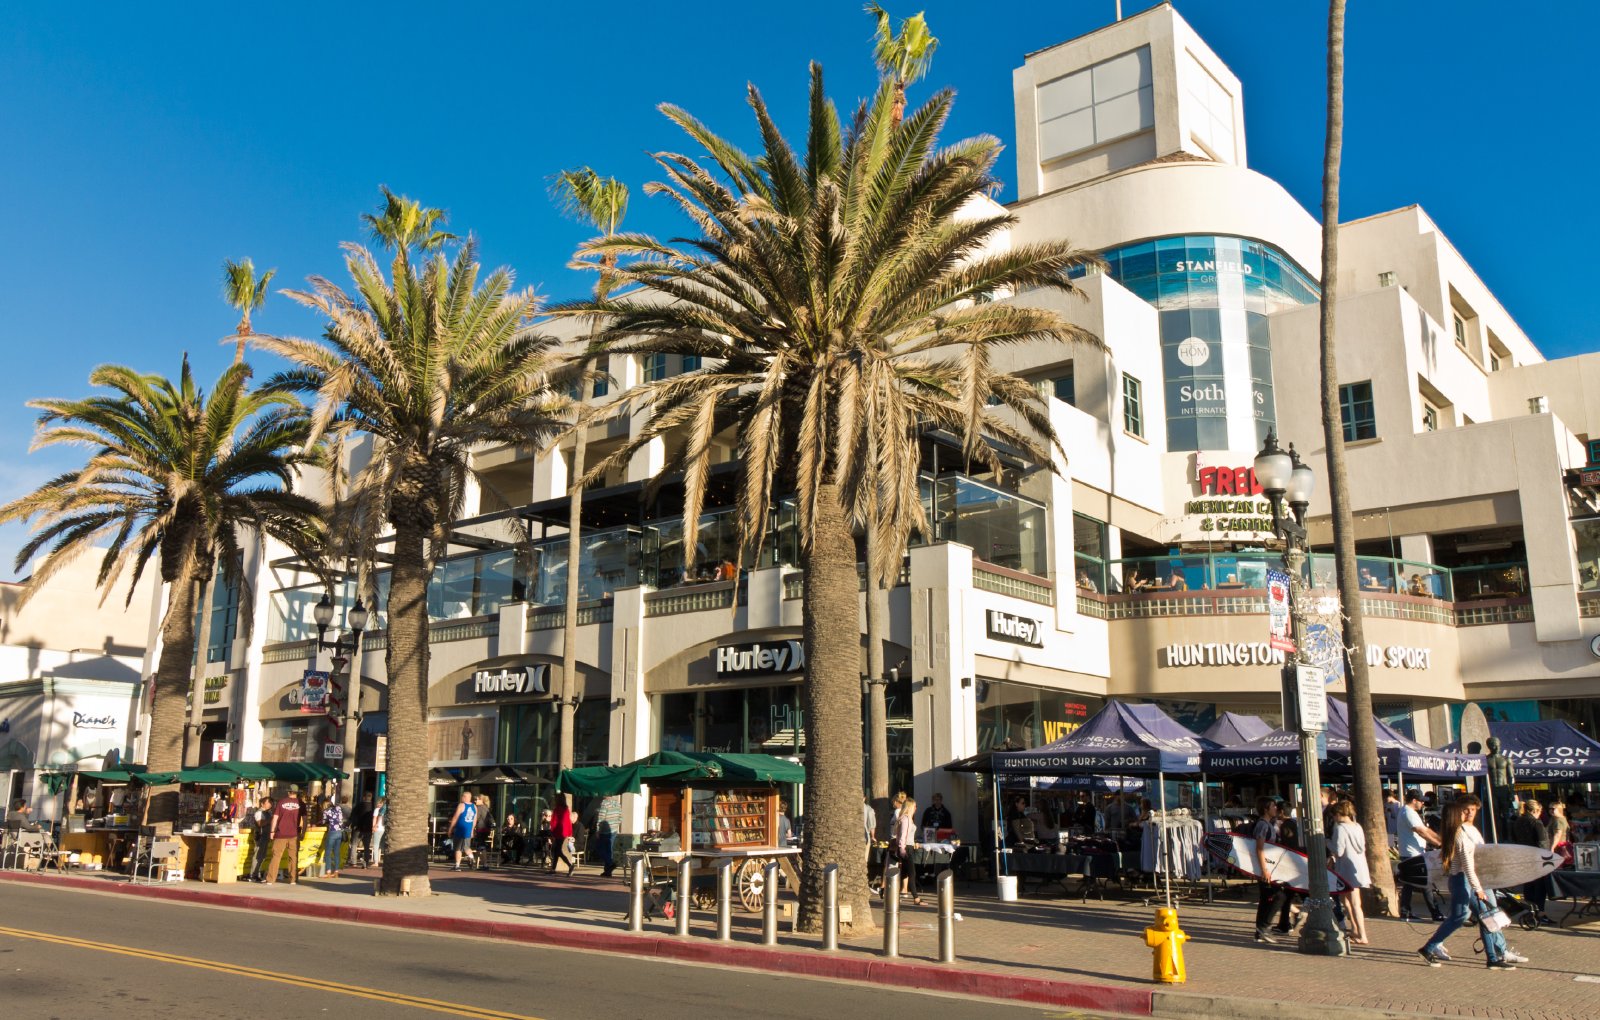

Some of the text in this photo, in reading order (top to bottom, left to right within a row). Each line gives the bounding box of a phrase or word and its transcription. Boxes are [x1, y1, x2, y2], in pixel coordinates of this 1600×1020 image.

[1176, 260, 1252, 274] STANFIELD
[1188, 500, 1254, 513] MEXICAN
[1202, 518, 1273, 530] & CANTIN
[991, 611, 1035, 643] Hurley
[717, 644, 789, 672] Hurley
[1166, 642, 1285, 667] HUNTINGTON
[1388, 645, 1430, 669] SPORT
[475, 669, 526, 692] Hurley
[73, 711, 117, 726] Diane's
[326, 745, 334, 753] NO
[1004, 757, 1068, 767] HUNTINGTON
[1072, 757, 1096, 766] SURF
[1113, 756, 1147, 766] SPORT
[1211, 756, 1288, 767] HUNTINGTON
[1407, 755, 1446, 770] HUNTINGTON
[1548, 769, 1581, 777] SPORT
[1581, 852, 1592, 866] 14
